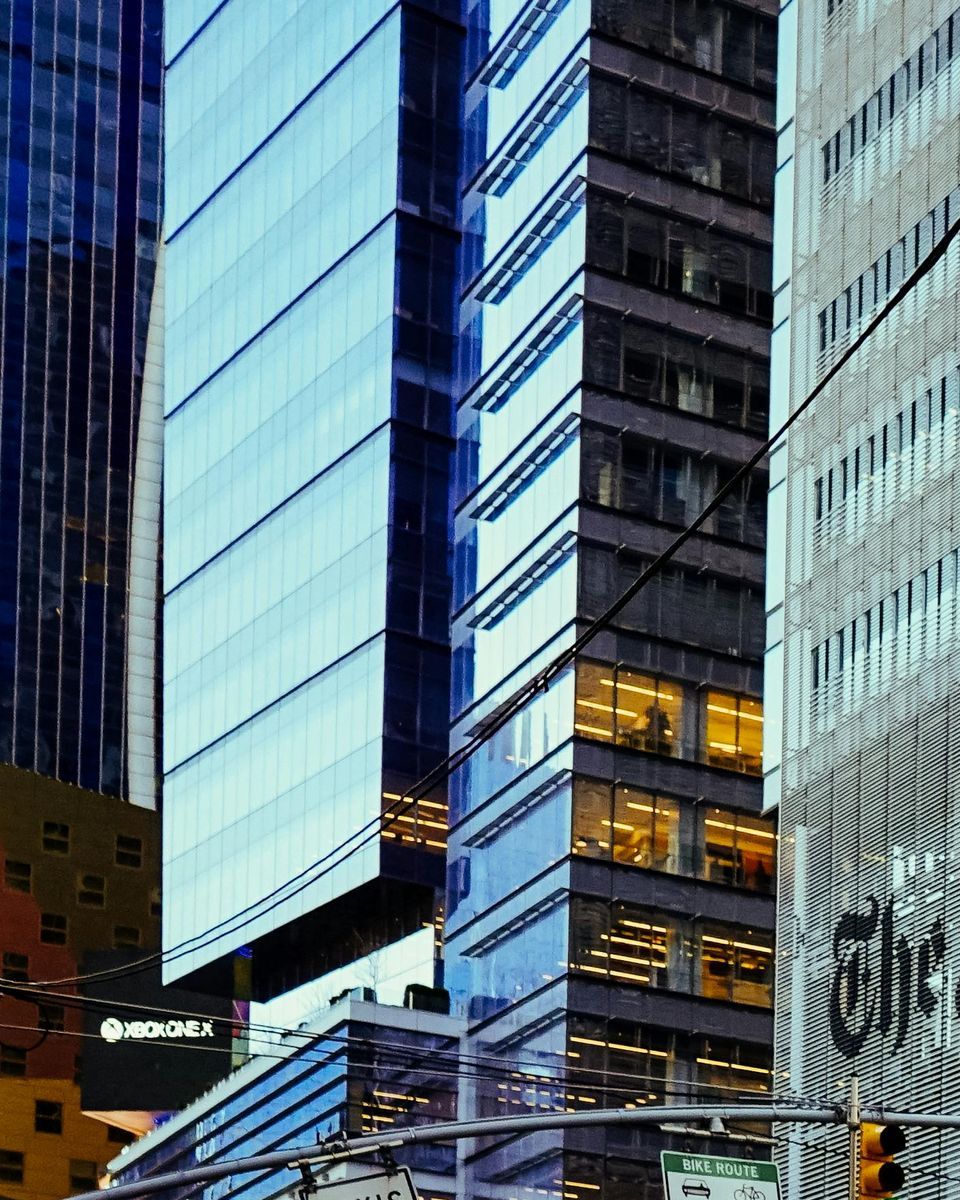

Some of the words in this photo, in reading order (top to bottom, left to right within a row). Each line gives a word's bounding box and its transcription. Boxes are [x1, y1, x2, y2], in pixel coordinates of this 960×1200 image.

[830, 893, 947, 1062] The
[124, 1020, 166, 1038] XBOX
[682, 1158, 712, 1174] BIKE
[716, 1162, 759, 1178] ROUTE
